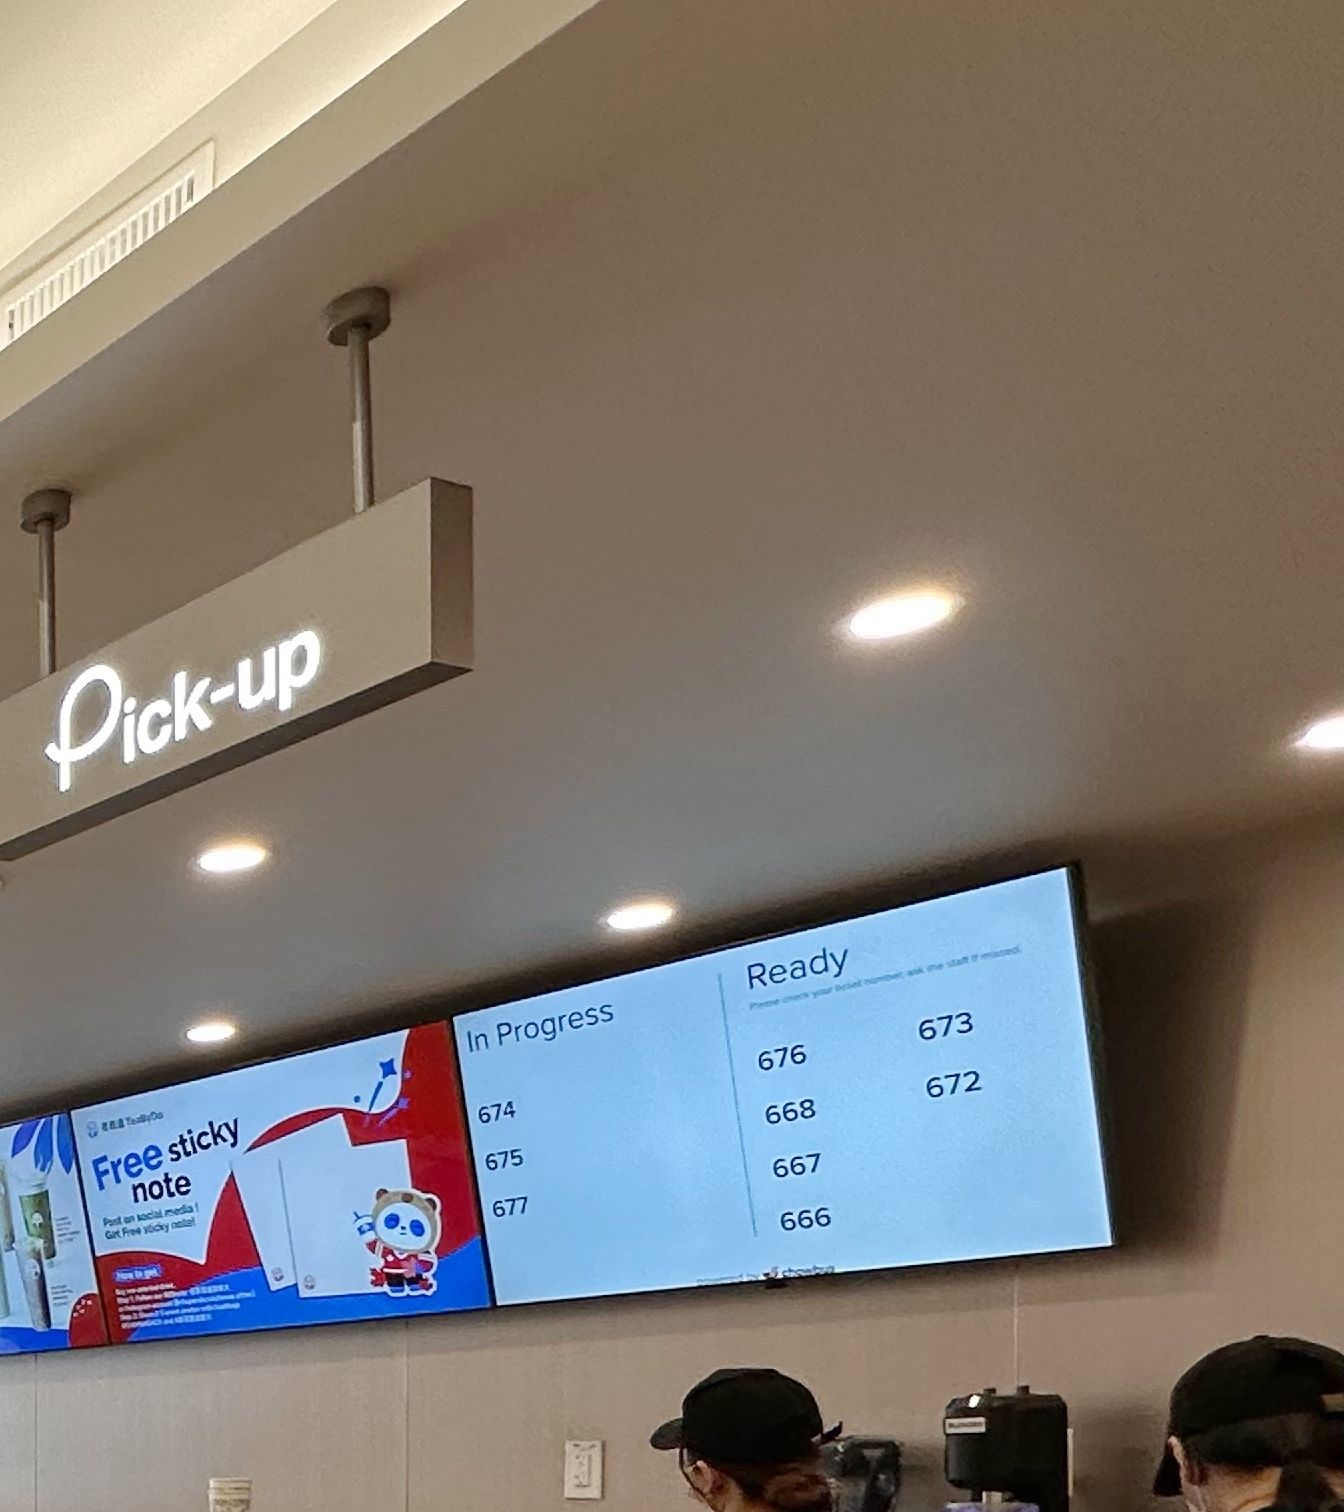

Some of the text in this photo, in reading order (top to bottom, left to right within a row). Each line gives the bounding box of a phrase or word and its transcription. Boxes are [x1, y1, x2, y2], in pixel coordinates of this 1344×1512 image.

[43, 629, 322, 793] Pick-up
[746, 947, 849, 989] Ready
[467, 1004, 615, 1053] In Progress
[918, 1013, 974, 1042] 673
[758, 1044, 807, 1072] 676
[926, 1070, 982, 1099] 672
[477, 1101, 517, 1125] 674
[764, 1099, 817, 1126] 668
[92, 1118, 239, 1191] Free sticky
[485, 1149, 524, 1172] 675
[772, 1153, 822, 1179] 667
[132, 1172, 192, 1203] note
[492, 1197, 529, 1219] 677
[780, 1207, 832, 1232] 666
